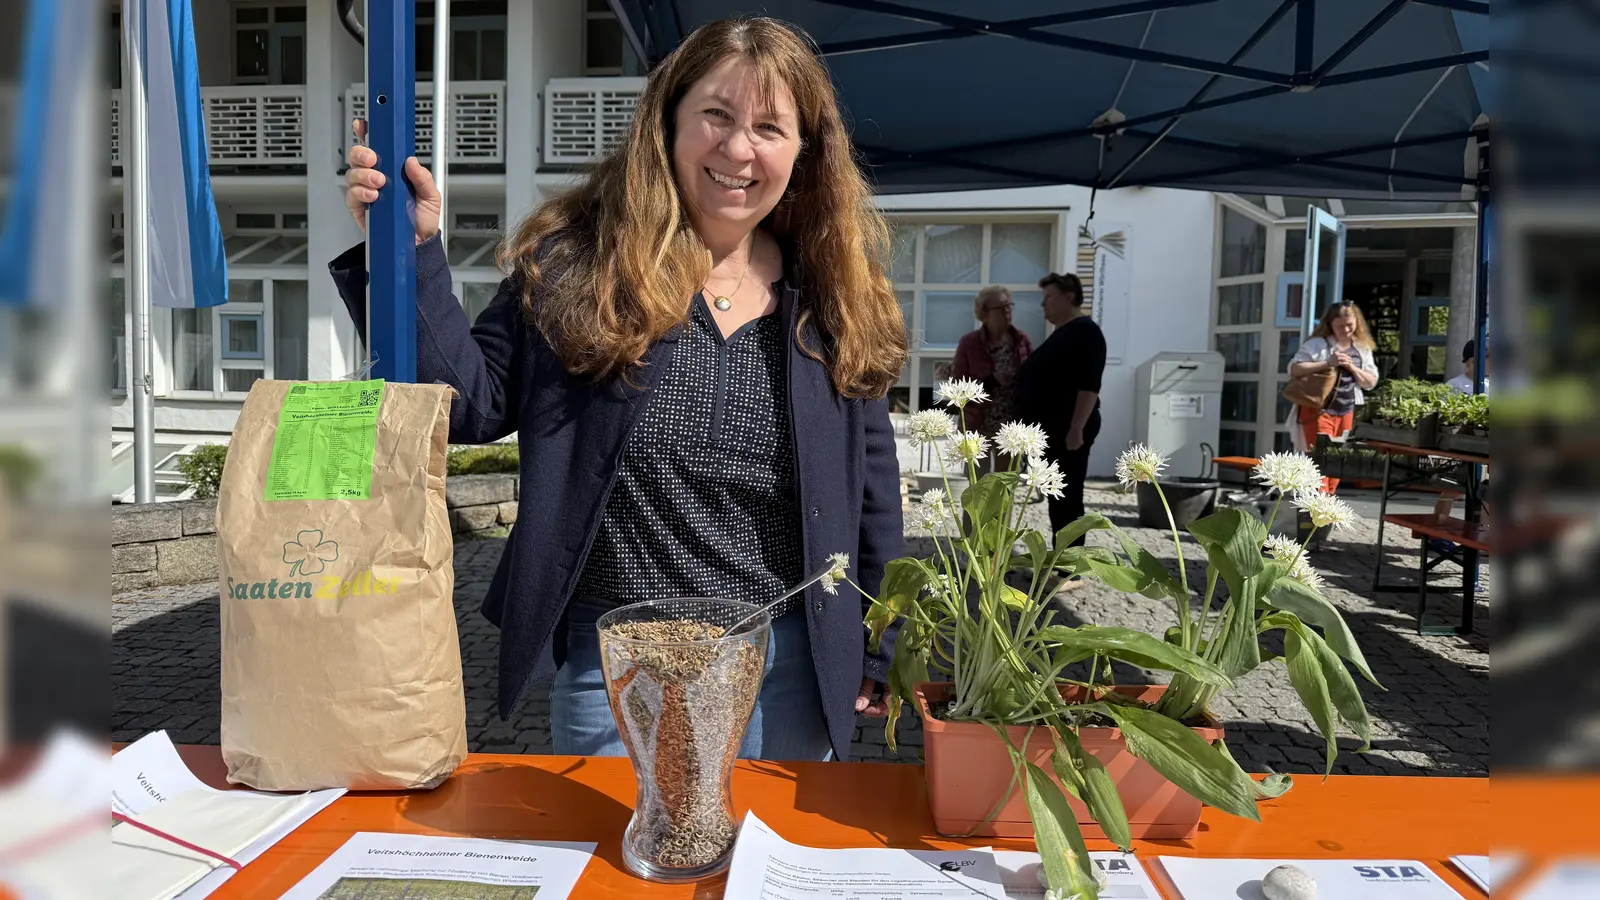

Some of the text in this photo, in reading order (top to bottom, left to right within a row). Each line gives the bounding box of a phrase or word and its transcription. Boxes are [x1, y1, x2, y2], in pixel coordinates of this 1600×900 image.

[367, 849, 538, 863] Veitshöchheimer Bienenweide
[1093, 859, 1131, 870] TA
[1353, 866, 1425, 878] STA
